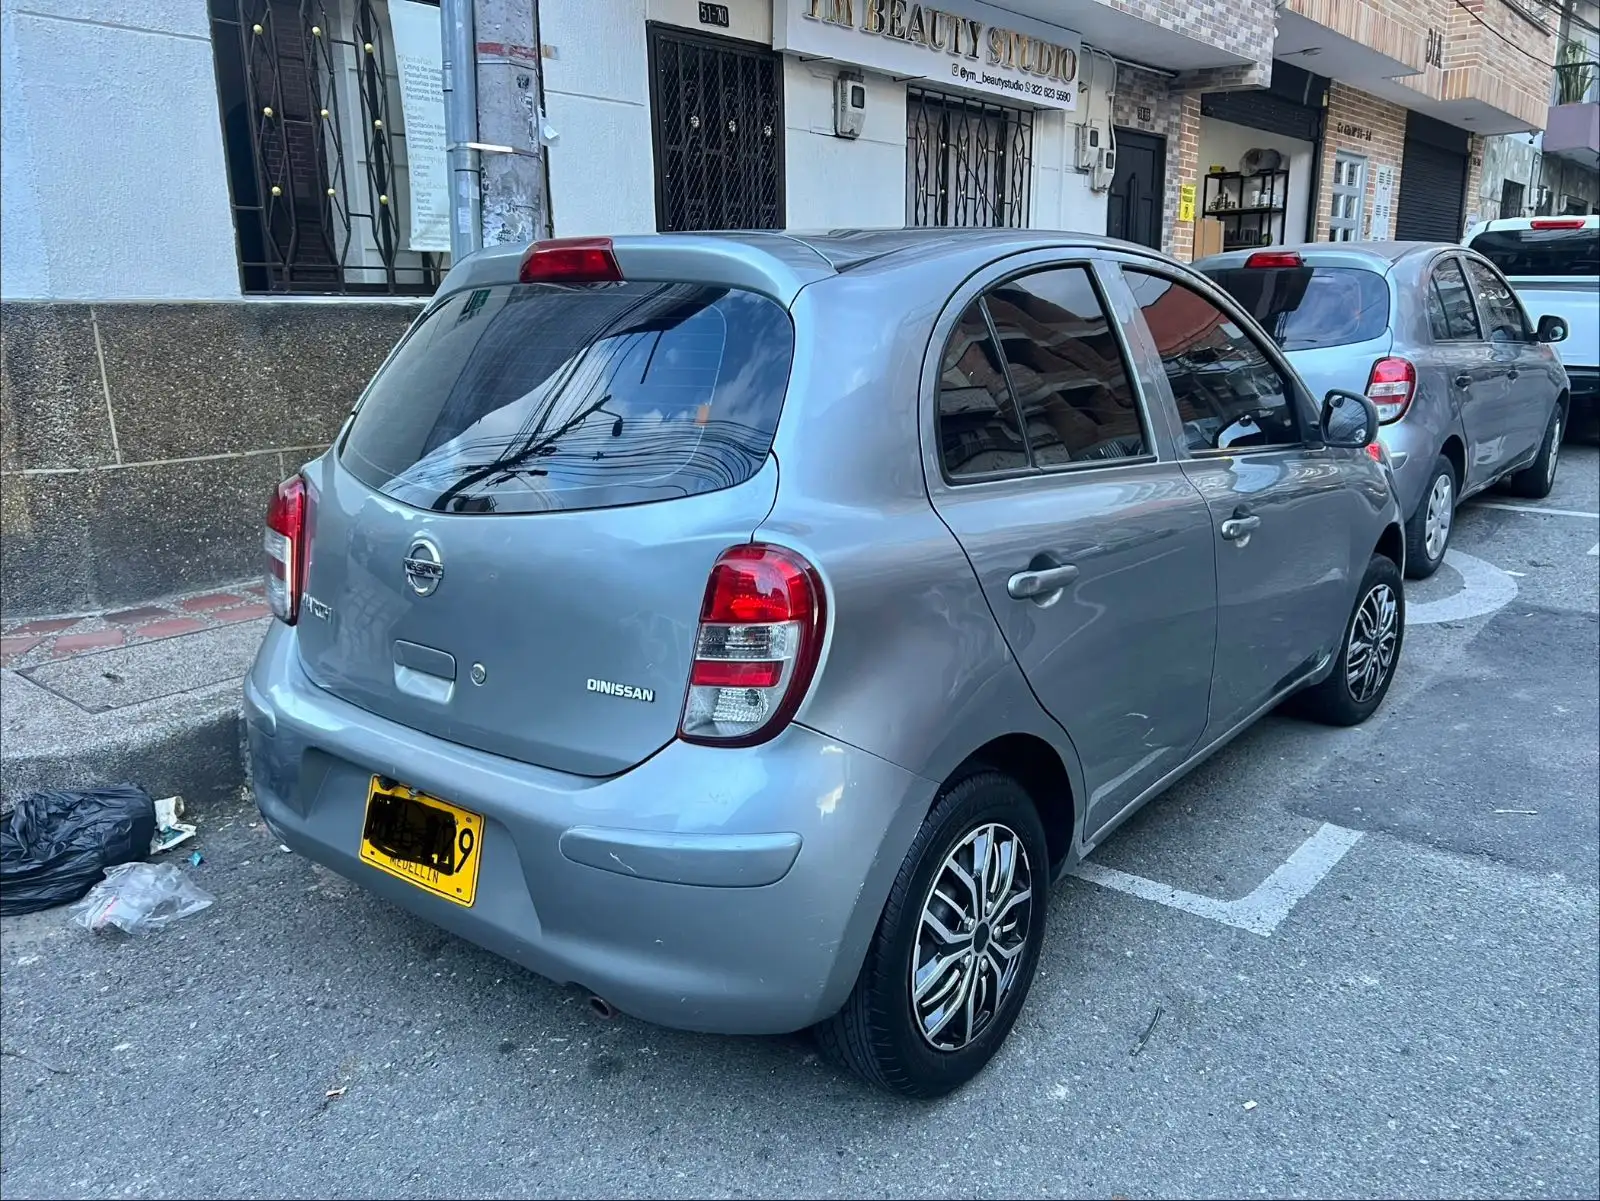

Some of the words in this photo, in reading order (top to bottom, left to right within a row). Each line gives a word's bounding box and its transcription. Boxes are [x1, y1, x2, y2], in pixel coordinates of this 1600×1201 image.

[858, 0, 985, 61] BEAUTY
[985, 26, 1078, 84] STUDIO
[1031, 85, 1043, 96] 322
[1044, 87, 1055, 99] 623
[586, 678, 655, 702] DINISSAN
